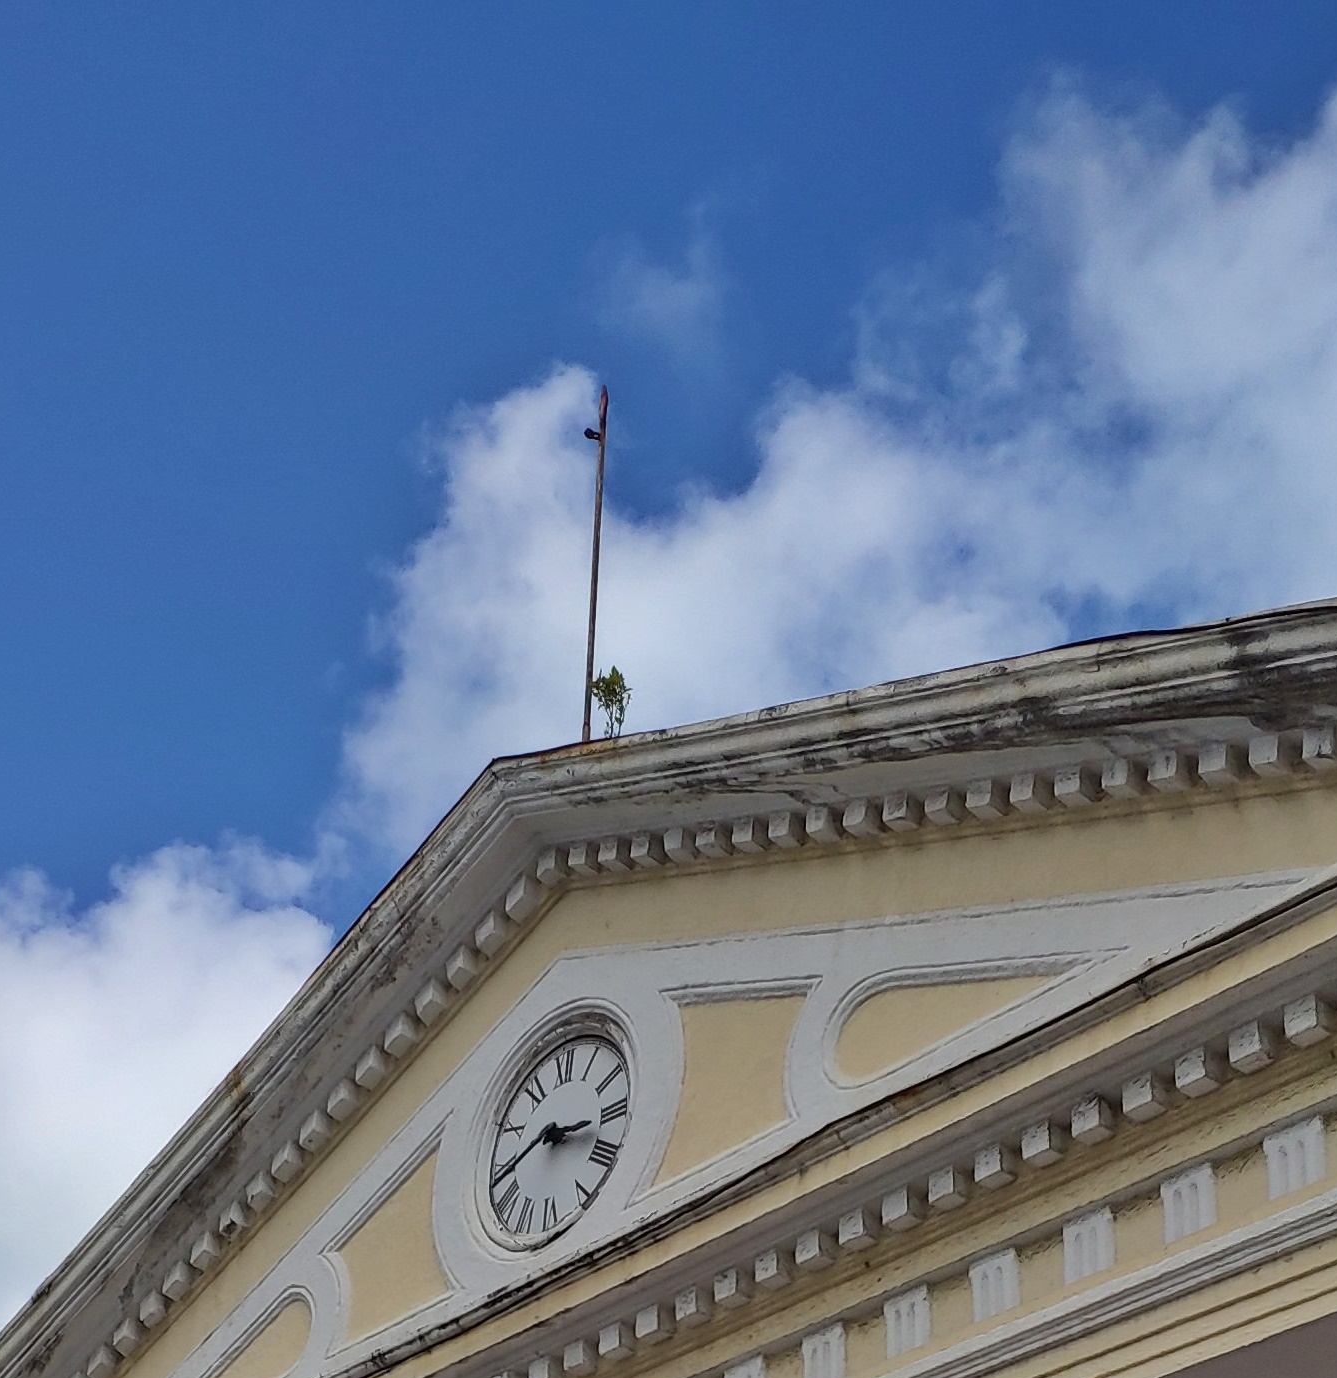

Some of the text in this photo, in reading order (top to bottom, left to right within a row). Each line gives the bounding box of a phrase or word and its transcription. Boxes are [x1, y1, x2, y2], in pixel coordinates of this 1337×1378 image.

[553, 1047, 577, 1091] XII
[580, 1046, 601, 1082] I
[595, 1062, 623, 1098] II
[524, 1074, 548, 1115] XI
[599, 1093, 628, 1129] III
[503, 1118, 527, 1140] X
[587, 1136, 621, 1168] IIII
